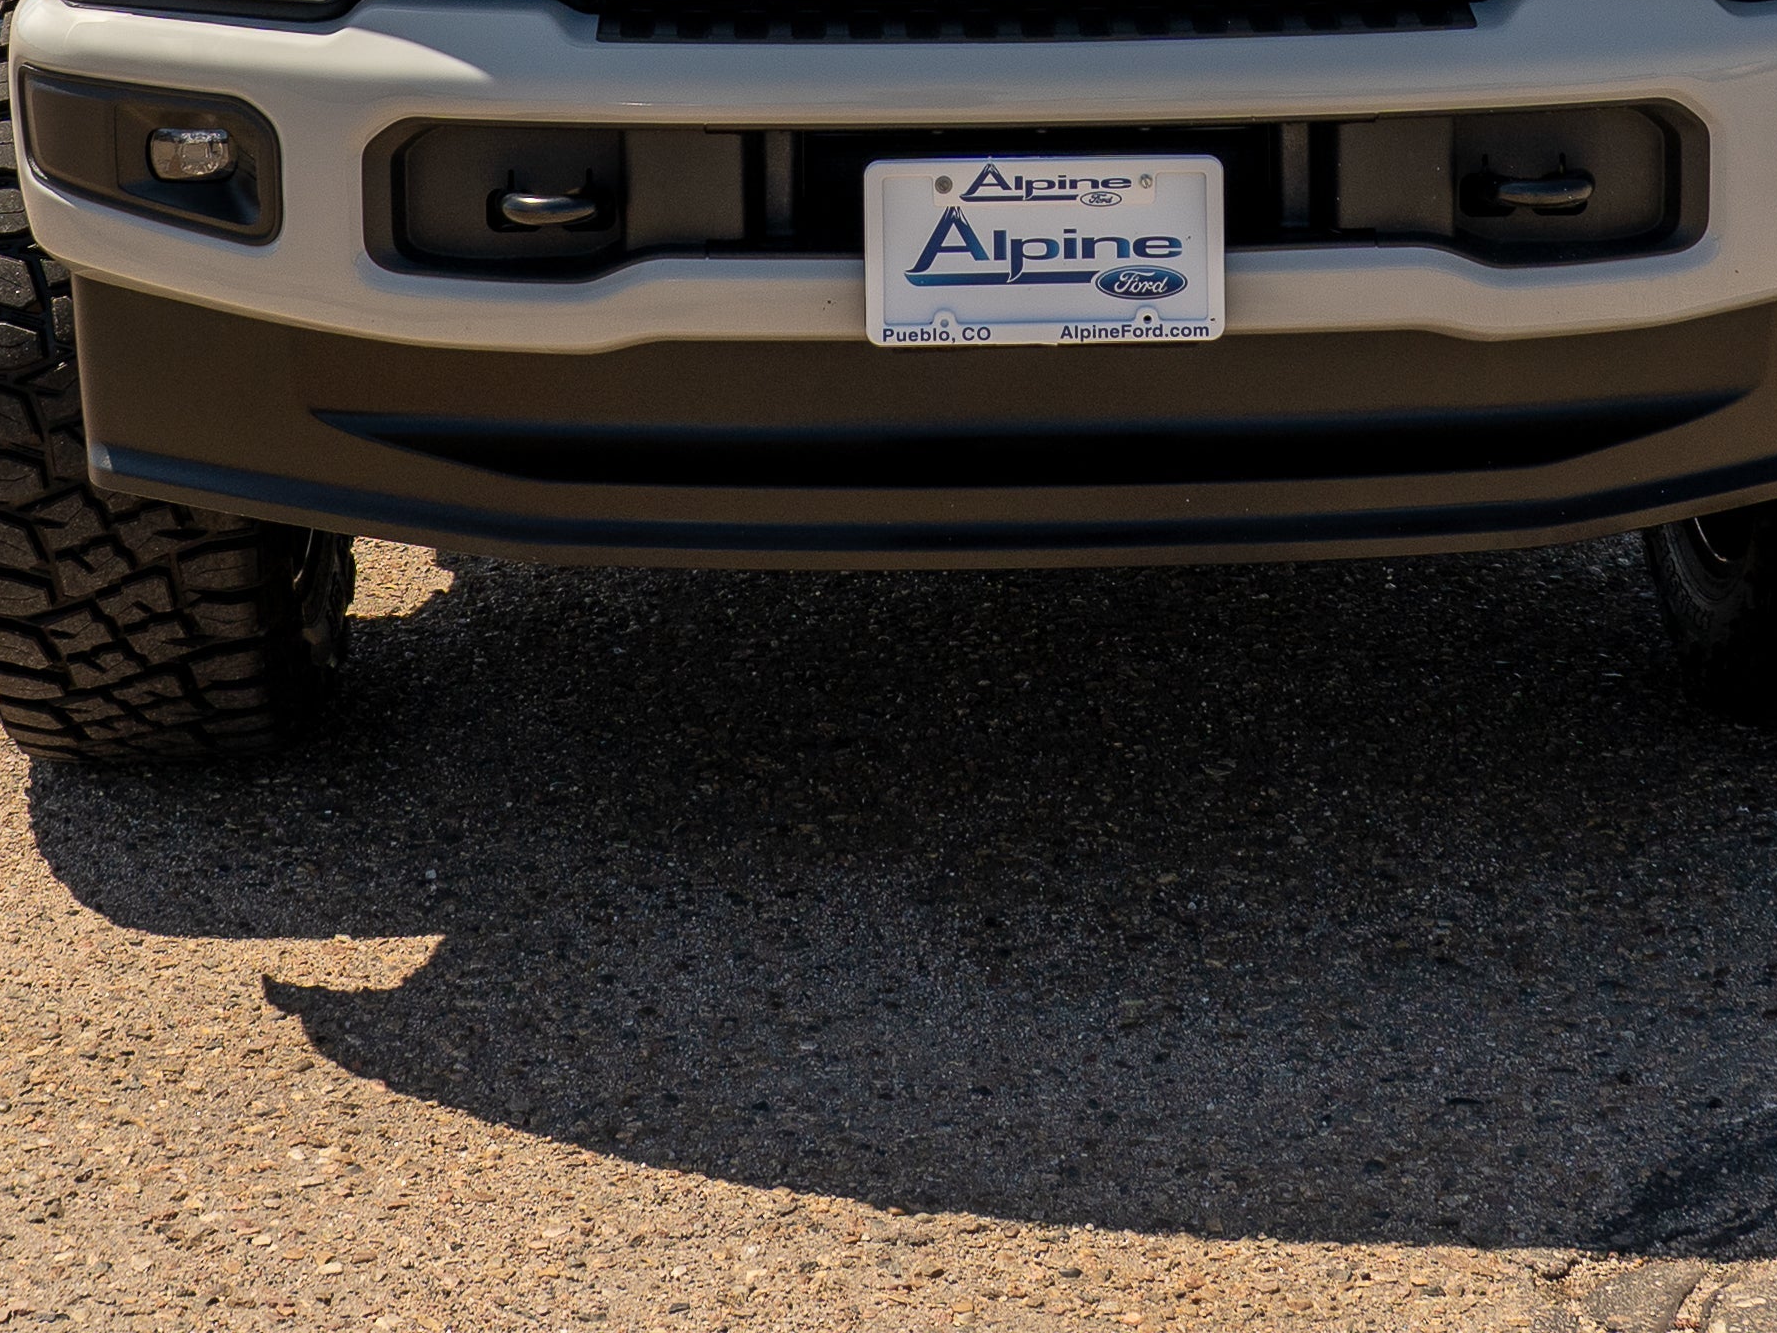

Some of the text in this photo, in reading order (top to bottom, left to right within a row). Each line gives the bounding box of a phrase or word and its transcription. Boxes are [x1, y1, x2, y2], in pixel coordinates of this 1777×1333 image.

[960, 162, 1132, 201] Alpine
[905, 205, 1183, 284] Alpine
[882, 326, 992, 343] Pueblo, CO
[1060, 323, 1209, 342] AlpineFord.com
